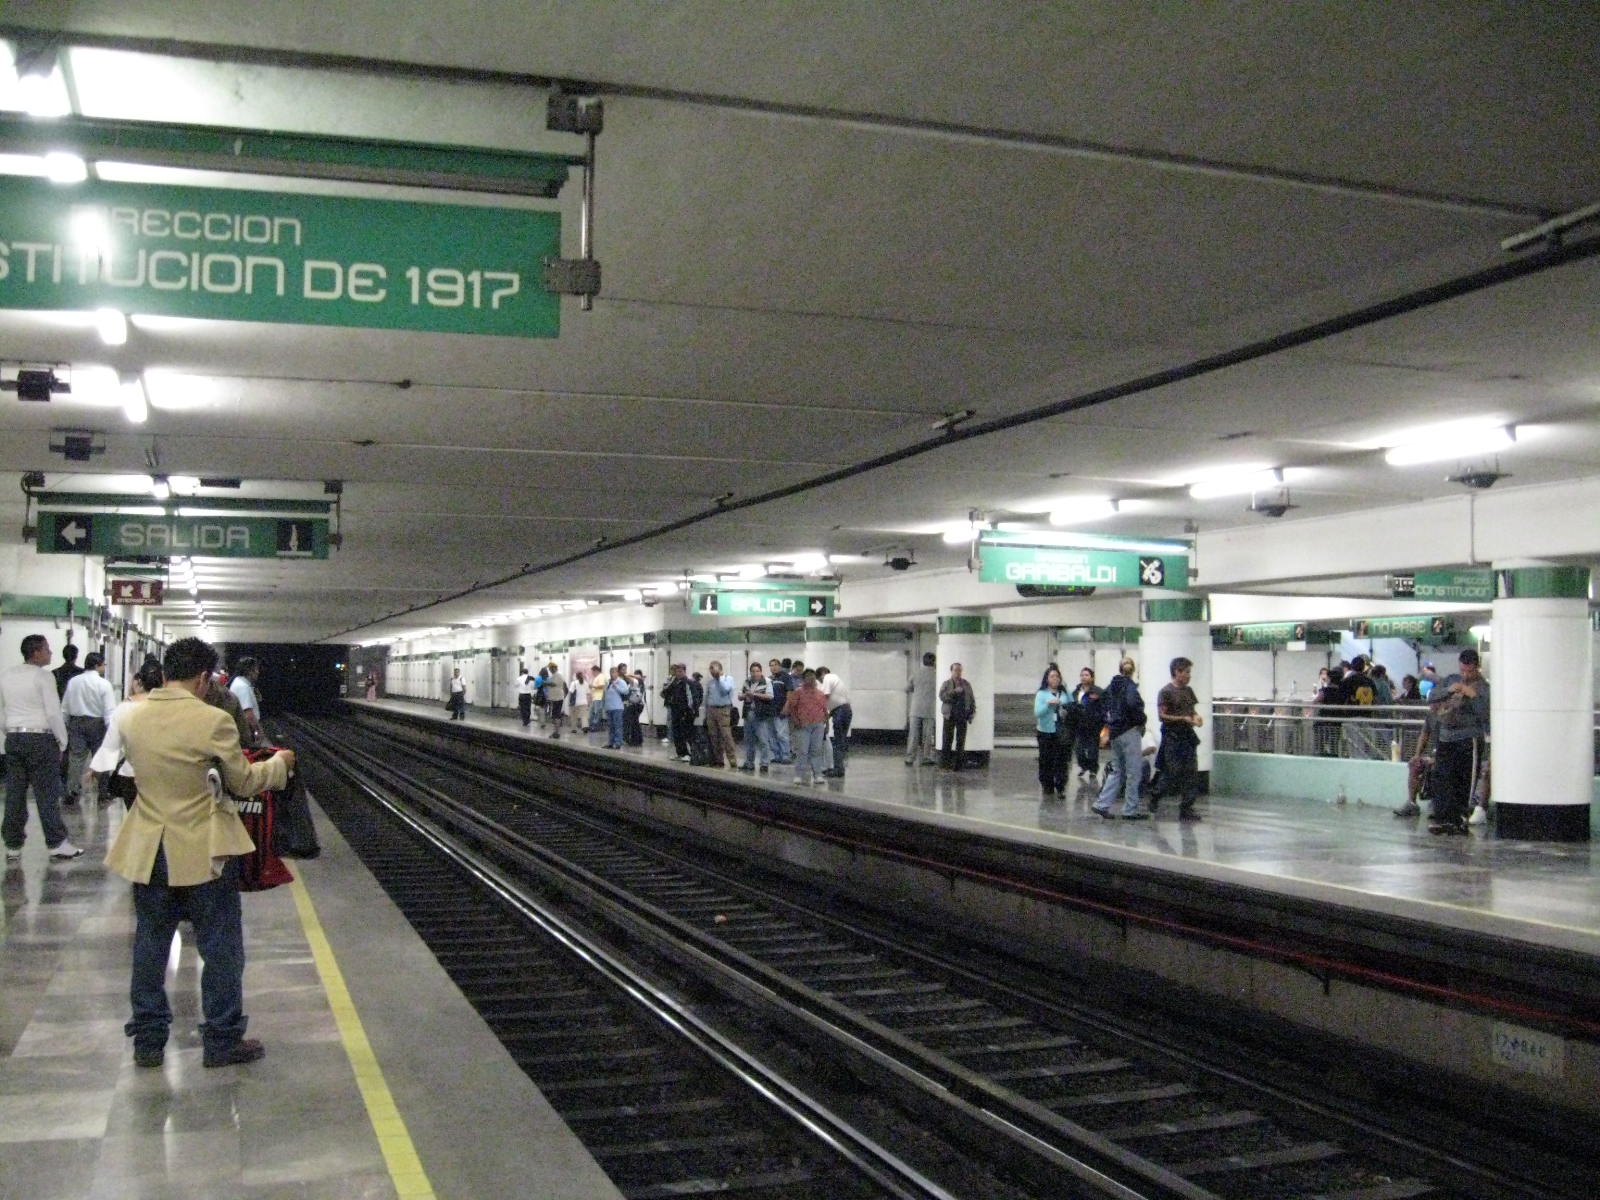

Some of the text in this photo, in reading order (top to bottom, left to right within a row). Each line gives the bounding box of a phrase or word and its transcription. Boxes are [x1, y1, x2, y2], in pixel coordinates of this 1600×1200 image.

[74, 204, 301, 245] RECCION
[0, 241, 521, 310] TITUCION DE 1917
[119, 522, 250, 549] SALIDA
[1005, 561, 1117, 583] GARIBALDI
[730, 596, 796, 613] SALIDA
